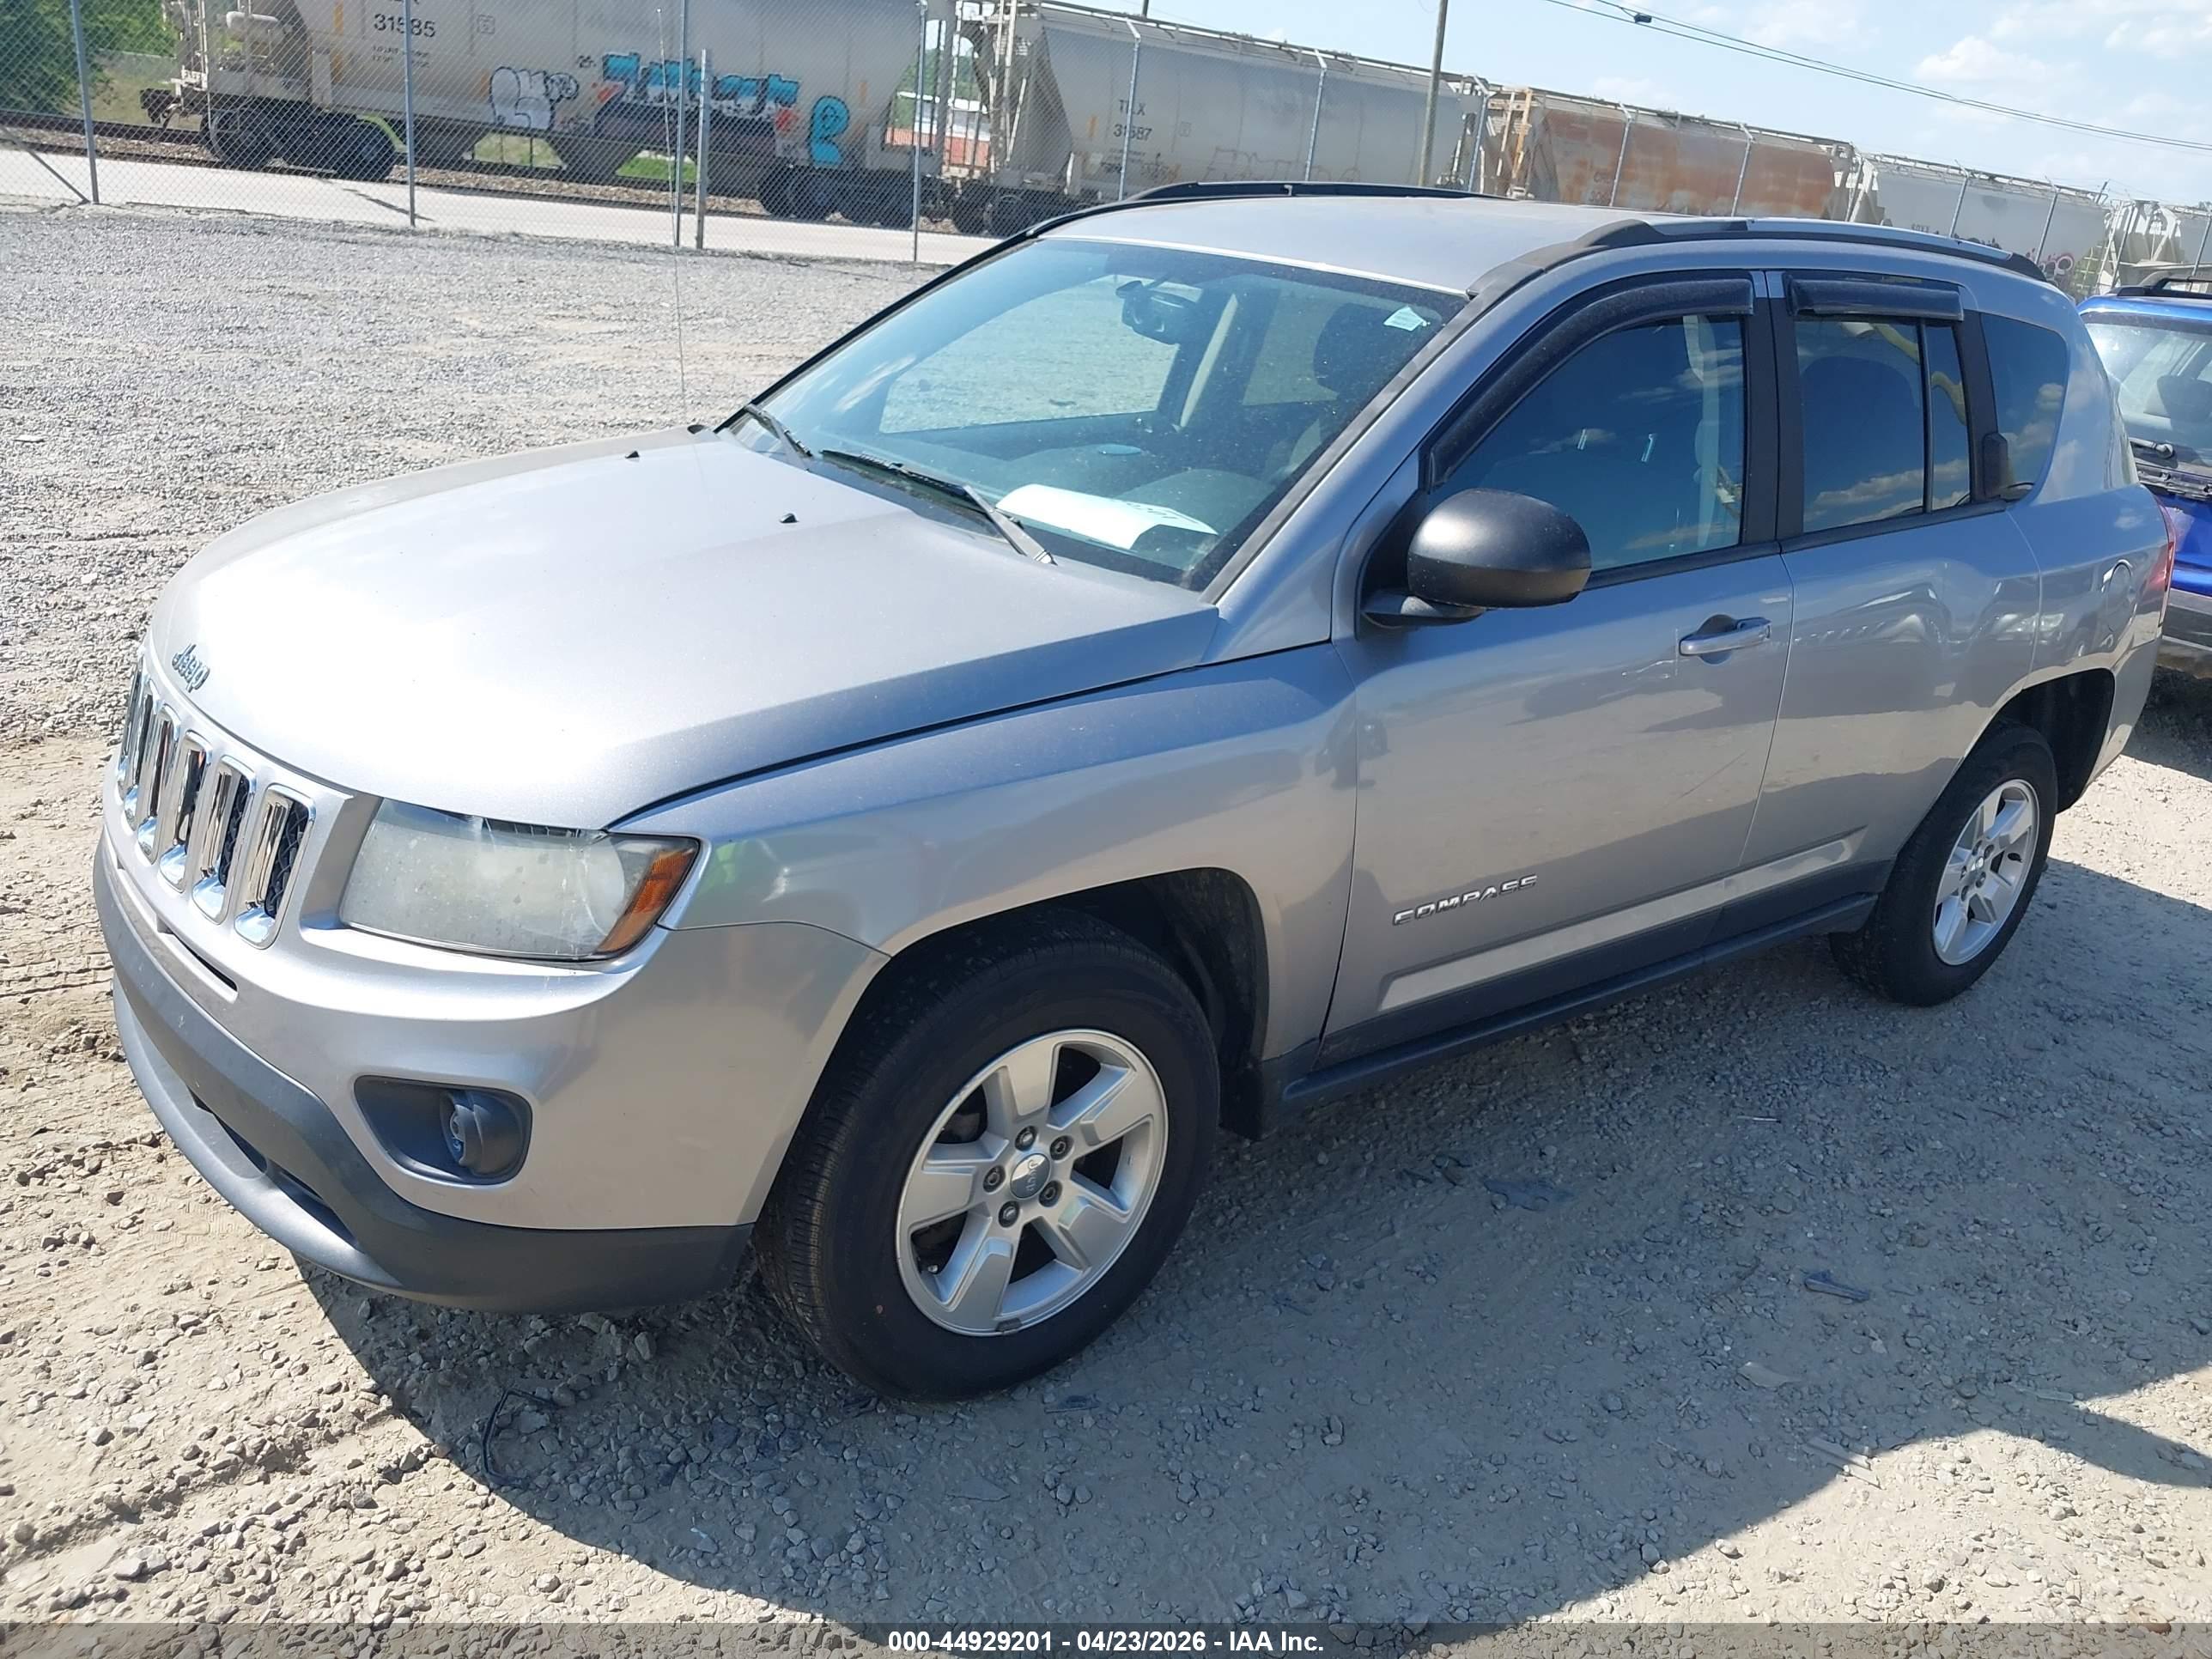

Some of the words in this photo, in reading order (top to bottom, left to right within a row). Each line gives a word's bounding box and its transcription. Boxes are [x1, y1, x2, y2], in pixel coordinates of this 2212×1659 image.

[374, 13, 436, 38] 31585
[172, 642, 210, 693] Jeep
[1393, 873, 1538, 927] COMPASS
